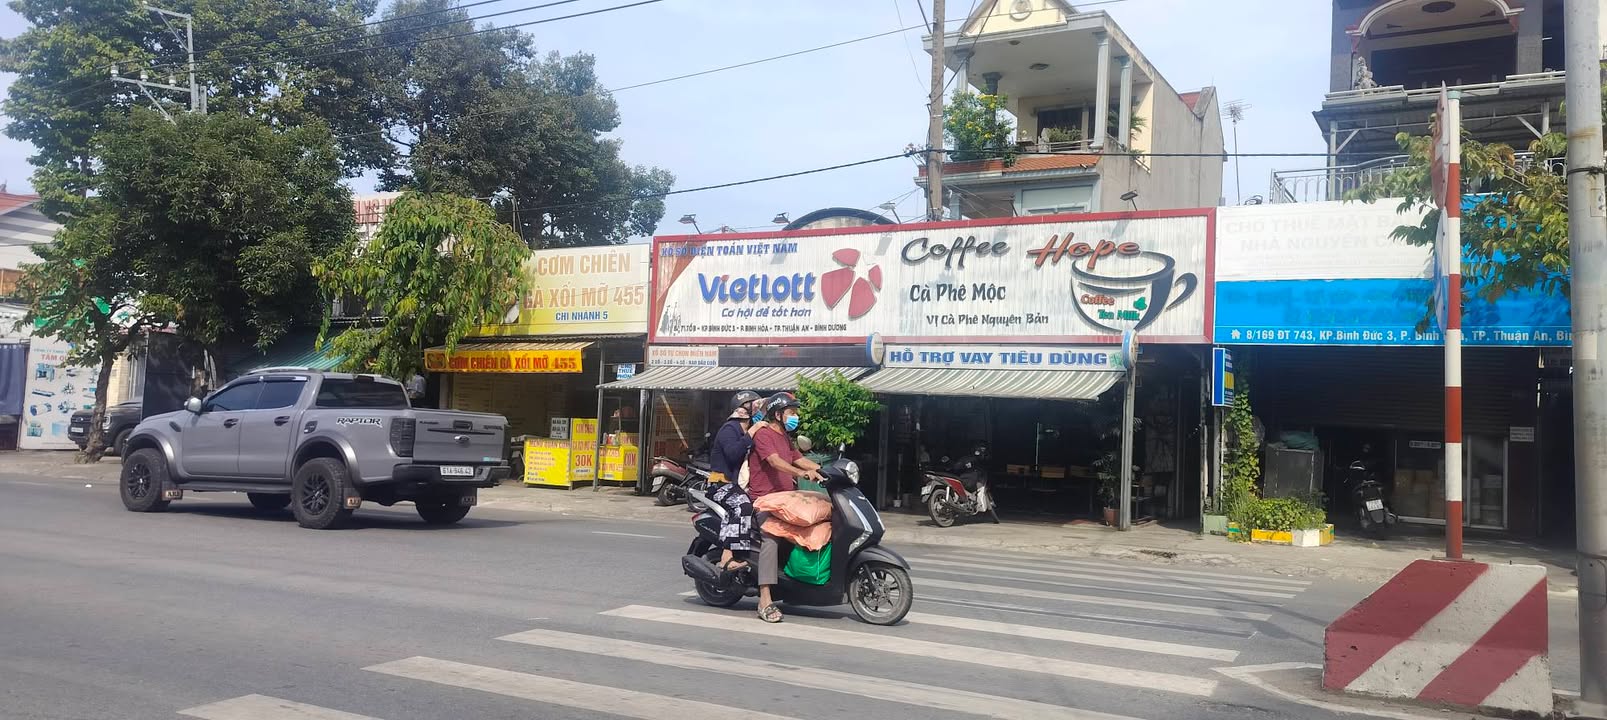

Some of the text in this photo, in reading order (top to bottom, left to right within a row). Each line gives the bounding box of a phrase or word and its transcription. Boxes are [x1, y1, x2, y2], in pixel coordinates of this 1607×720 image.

[716, 242, 743, 256] TOÁN
[747, 242, 770, 256] VIỆT
[773, 243, 798, 254] NAM
[901, 232, 1141, 269] Coffee Hope
[537, 249, 631, 275] CƠM CHIÊN
[524, 281, 644, 308] GÀ XỐI MỠ 455
[698, 272, 817, 303] Vietlott
[910, 283, 1006, 304] Cà Phê Mộc
[1080, 294, 1115, 306] Coffee
[556, 310, 608, 320] CHI NHÁNH 5
[722, 306, 811, 319] Cơ hội để tốt hơn
[1098, 309, 1140, 320] Tea Milk
[941, 315, 955, 325] Cà
[958, 315, 978, 325] Phê
[981, 314, 1021, 327] Nguyên
[1026, 313, 1049, 325] Bản
[801, 324, 809, 332] AN
[1246, 330, 1274, 341] 8/169
[1277, 330, 1291, 340] ĐT
[1294, 330, 1316, 342] 743,
[1362, 329, 1383, 340] Đức
[1401, 330, 1411, 340] P.
[1472, 330, 1490, 341] TP.
[1495, 330, 1529, 344] Thuận
[1534, 330, 1552, 343] An,
[450, 355, 468, 369] CƠM
[471, 354, 497, 369] CHIÊN
[515, 353, 529, 369] XỐI
[533, 354, 548, 369] MỠ
[552, 358, 576, 369] 455
[889, 348, 1107, 366] HỖ TRỢ VAY TIÊU DÙNG
[336, 416, 383, 427] RAPTOR
[575, 454, 592, 467] 30K
